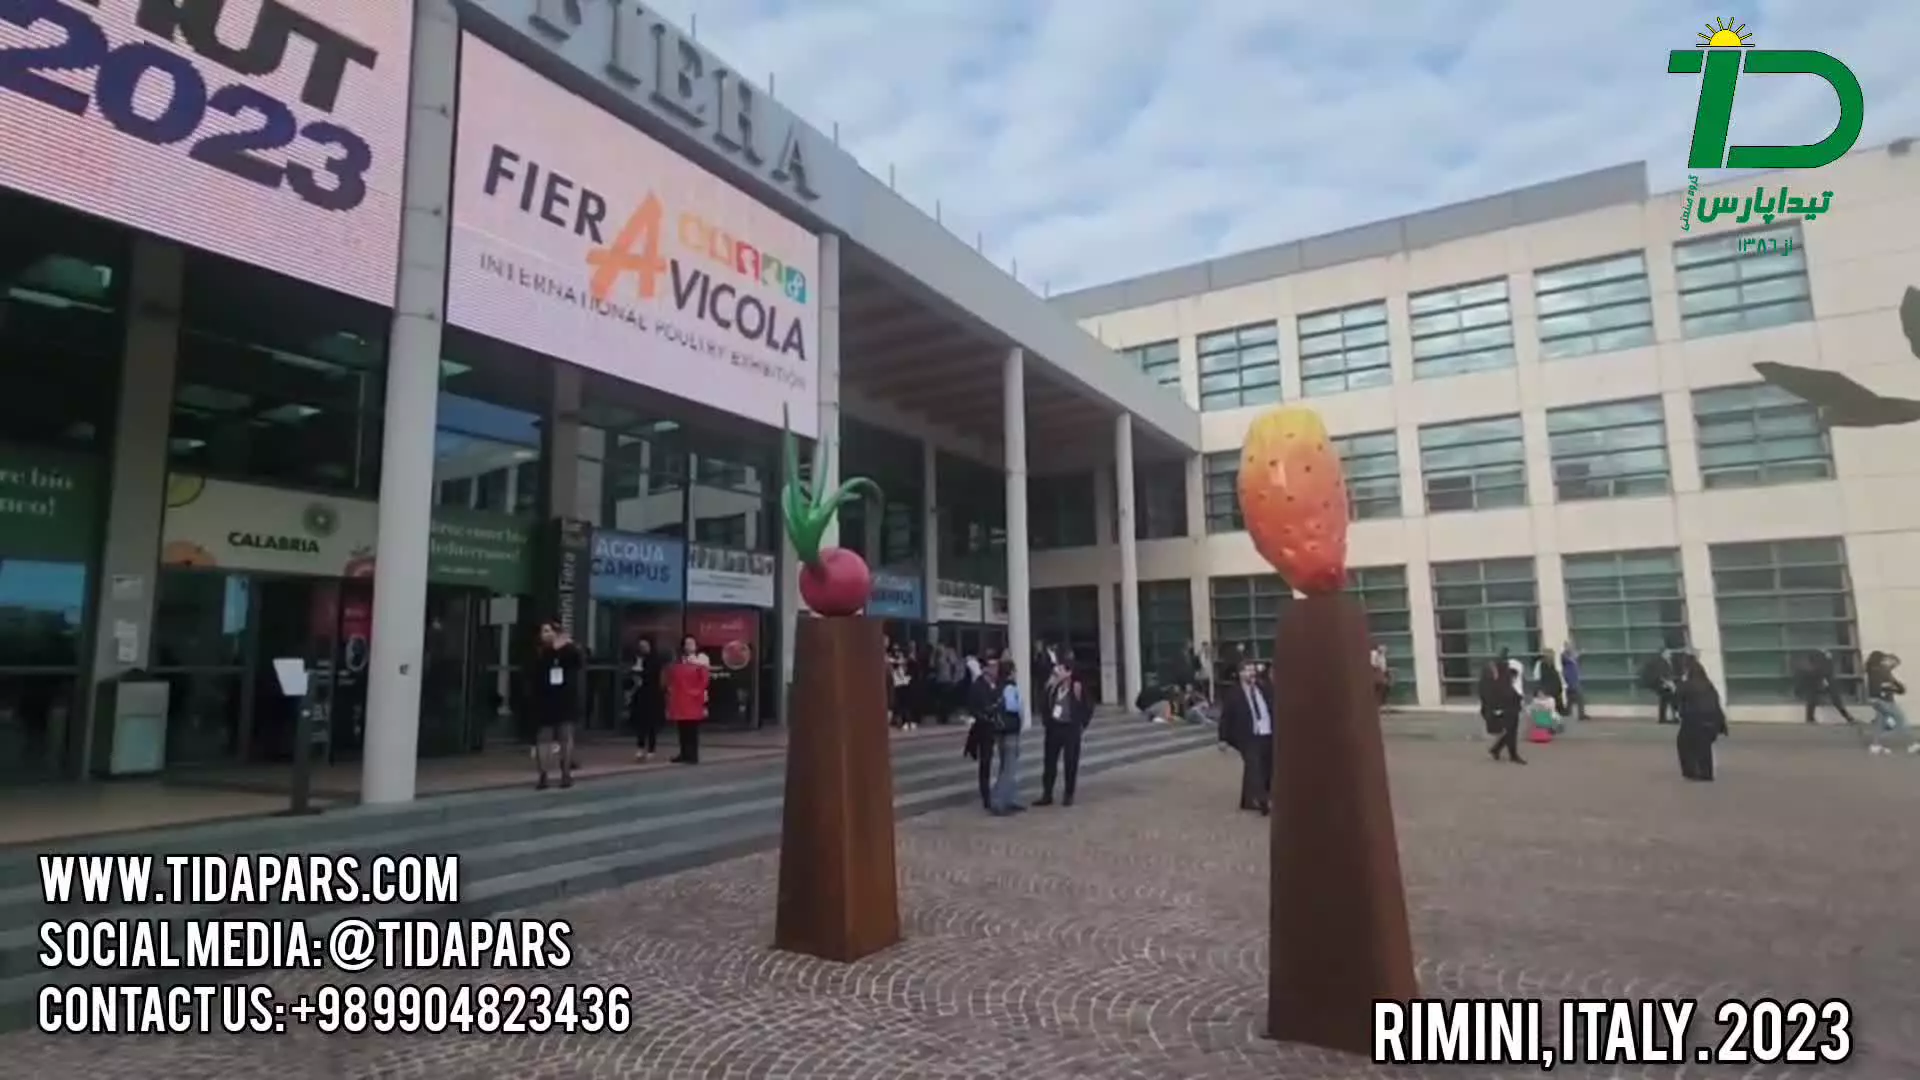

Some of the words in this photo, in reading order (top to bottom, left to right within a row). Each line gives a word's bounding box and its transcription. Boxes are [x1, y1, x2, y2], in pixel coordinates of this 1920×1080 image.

[0, 0, 372, 211] 2023
[228, 531, 320, 553] CALABRIA
[595, 538, 665, 562] ACQUA
[591, 558, 672, 584] CAMPUS
